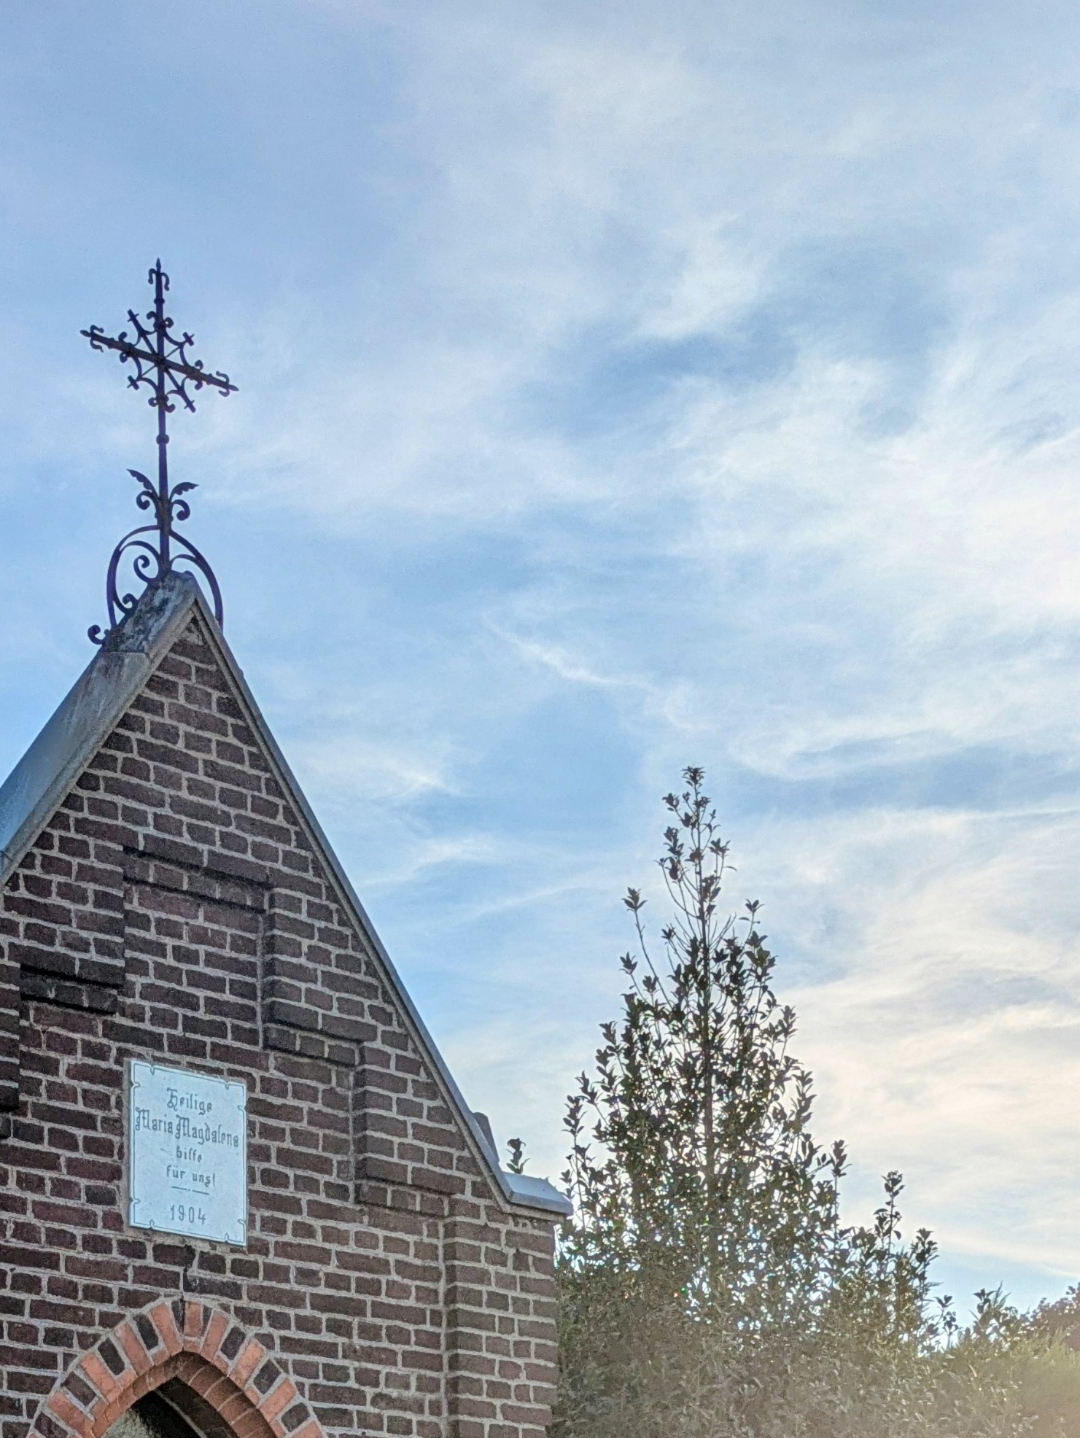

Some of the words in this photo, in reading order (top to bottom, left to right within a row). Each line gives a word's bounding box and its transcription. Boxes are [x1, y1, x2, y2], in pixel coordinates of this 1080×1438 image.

[166, 1087, 213, 1116] Heilige
[135, 1107, 174, 1135] Maria
[175, 1114, 239, 1148] Magdalena
[166, 1164, 186, 1180] für
[169, 1204, 207, 1225] 1904
